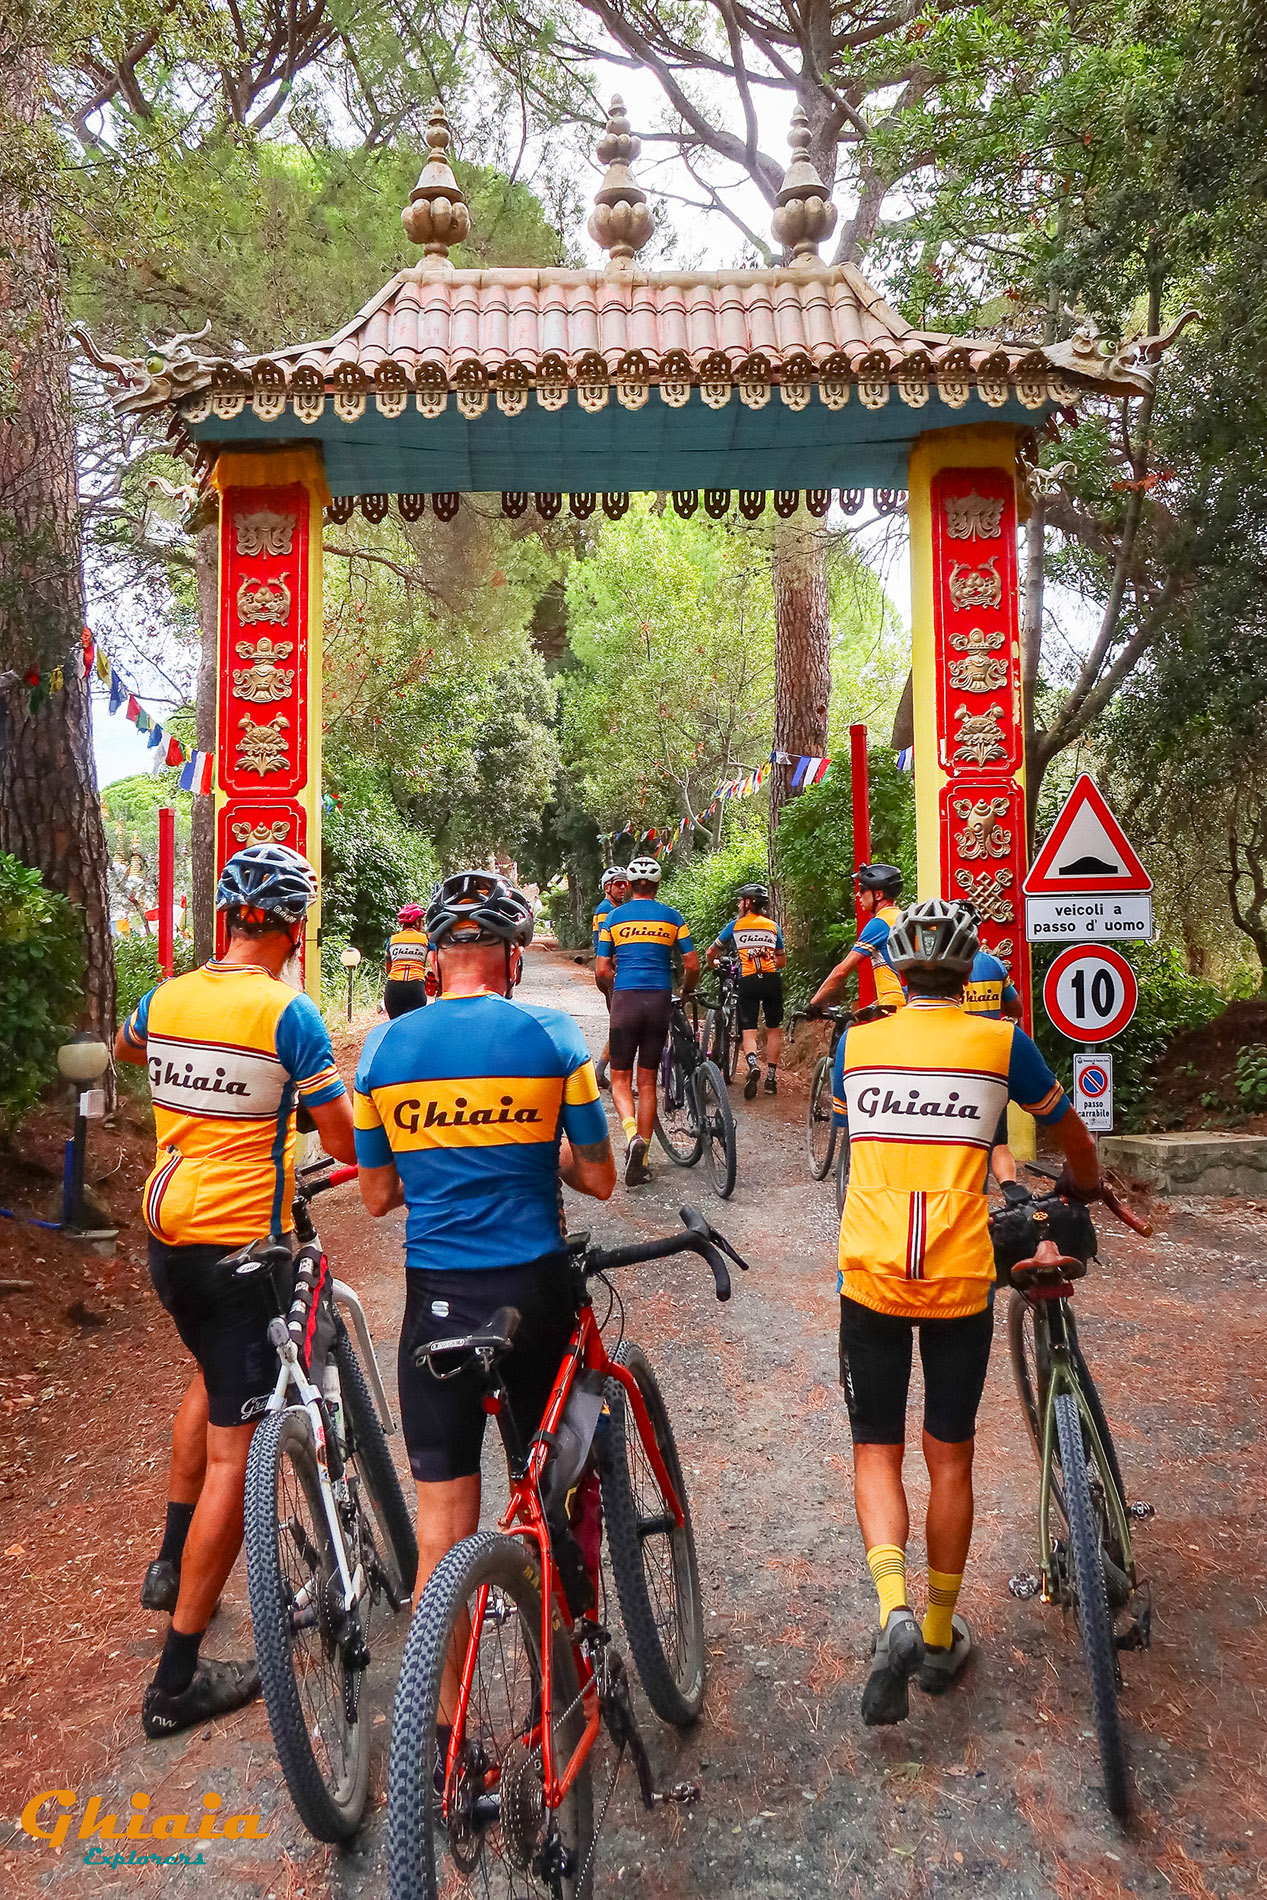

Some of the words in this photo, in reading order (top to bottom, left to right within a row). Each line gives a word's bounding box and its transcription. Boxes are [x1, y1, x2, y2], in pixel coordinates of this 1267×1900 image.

[1055, 903, 1103, 916] veicoli
[1113, 905, 1122, 915] a
[619, 926, 671, 939] Ghiaia
[1034, 922, 1076, 935] passo
[1086, 919, 1097, 931] d'
[1105, 921, 1145, 931] uomo
[739, 934, 775, 944] Ghiaia
[392, 947, 425, 957] Ghiaia
[1071, 968, 1115, 1019] 10
[148, 1056, 252, 1097] Ghiaia
[857, 1087, 981, 1120] Ghiaia
[1084, 1101, 1104, 1109] passo
[394, 1095, 543, 1135] Ghiaia
